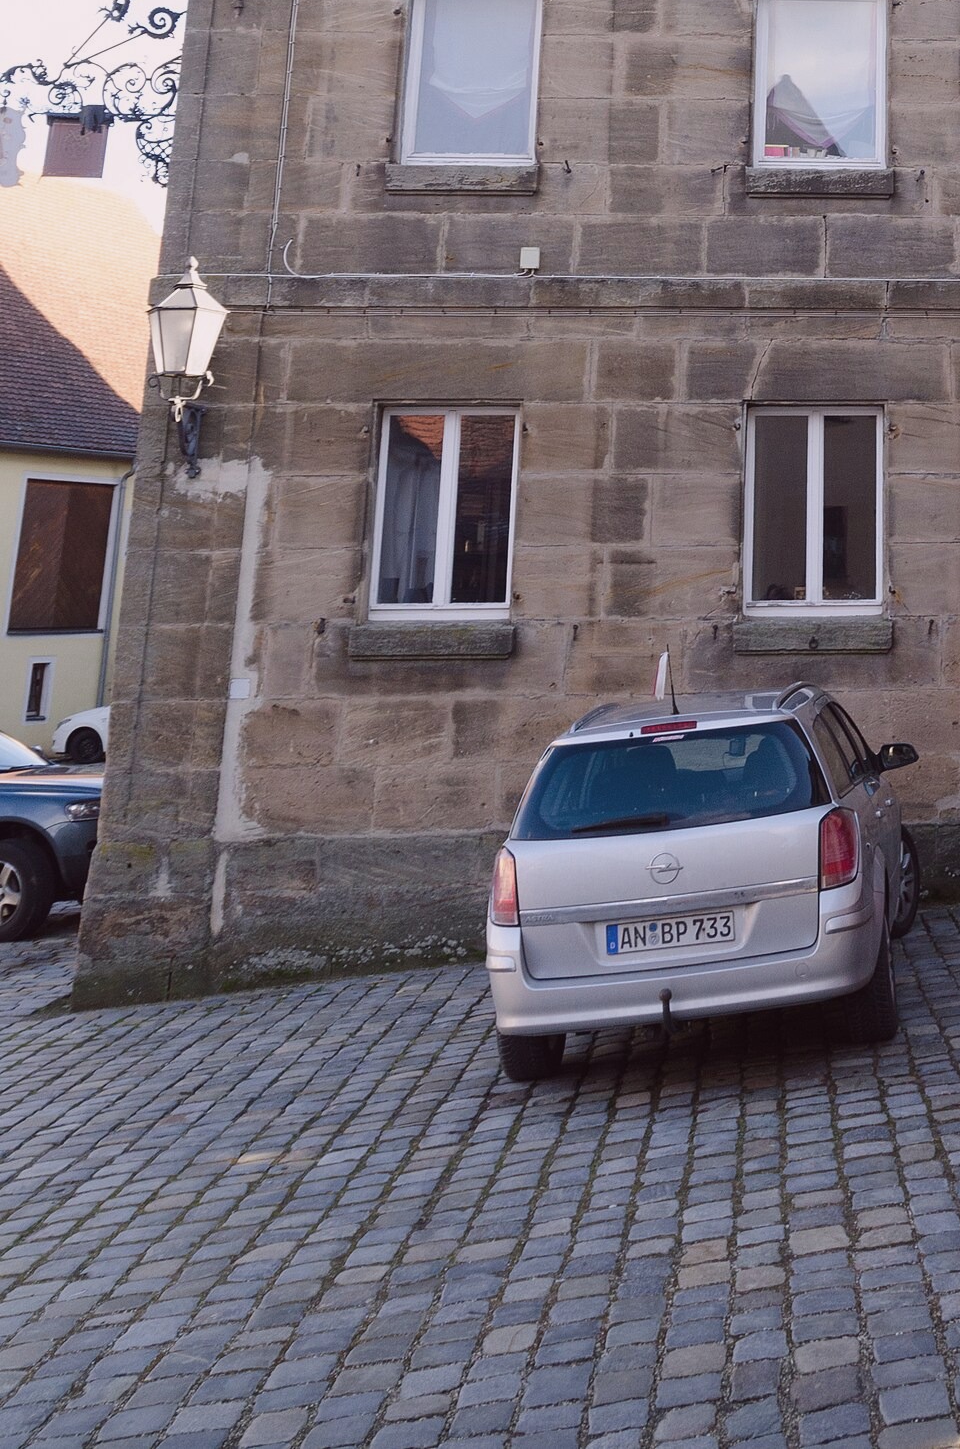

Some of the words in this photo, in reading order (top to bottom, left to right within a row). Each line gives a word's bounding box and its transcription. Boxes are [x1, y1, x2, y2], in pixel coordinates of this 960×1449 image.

[620, 925, 647, 949] AN
[661, 920, 688, 944] BP
[692, 915, 731, 941] 733
